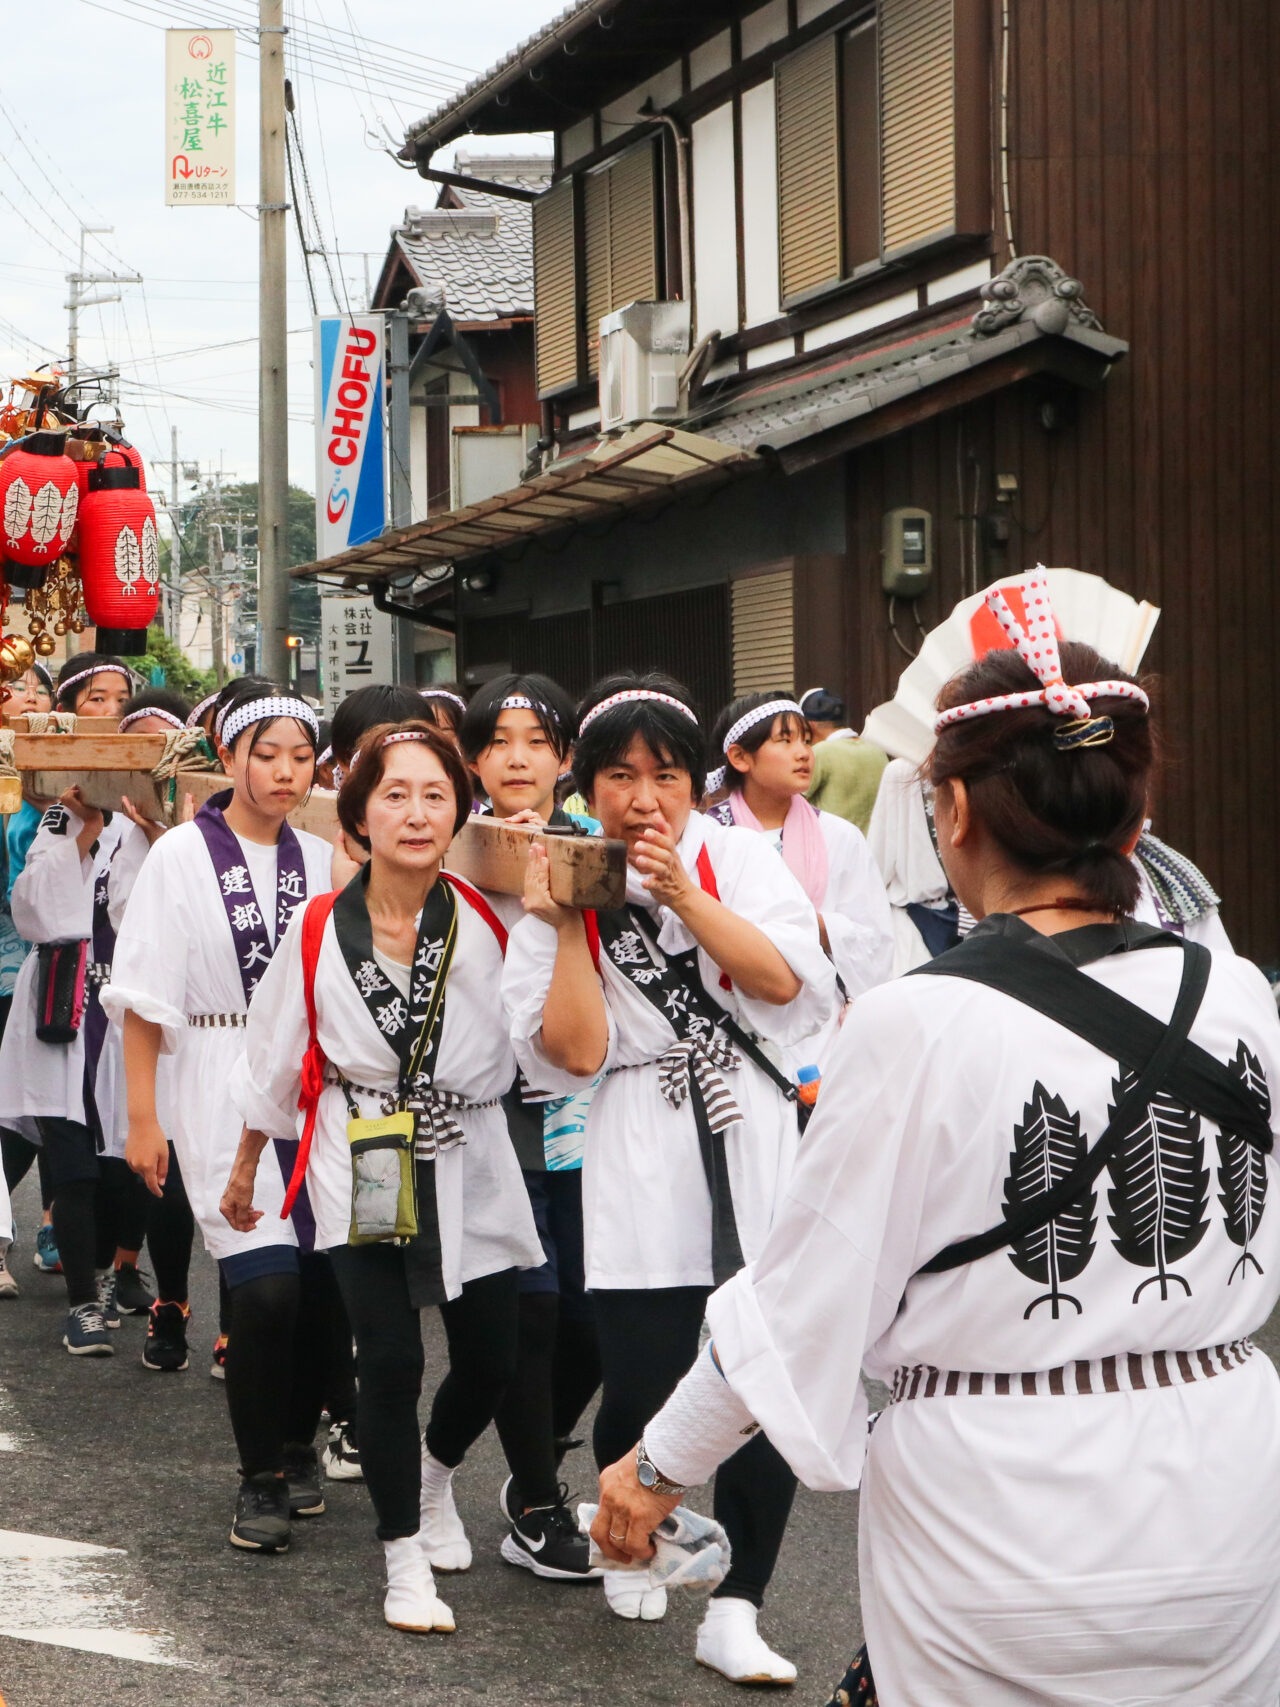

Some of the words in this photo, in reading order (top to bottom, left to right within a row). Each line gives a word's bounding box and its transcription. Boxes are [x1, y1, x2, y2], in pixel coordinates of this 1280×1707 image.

[179, 76, 204, 151] 松喜屋
[206, 62, 228, 137] 近江牛
[195, 165, 228, 178] Uターン
[327, 327, 376, 466] CHOFU
[278, 869, 304, 940] 近江
[355, 960, 408, 1036] 建部
